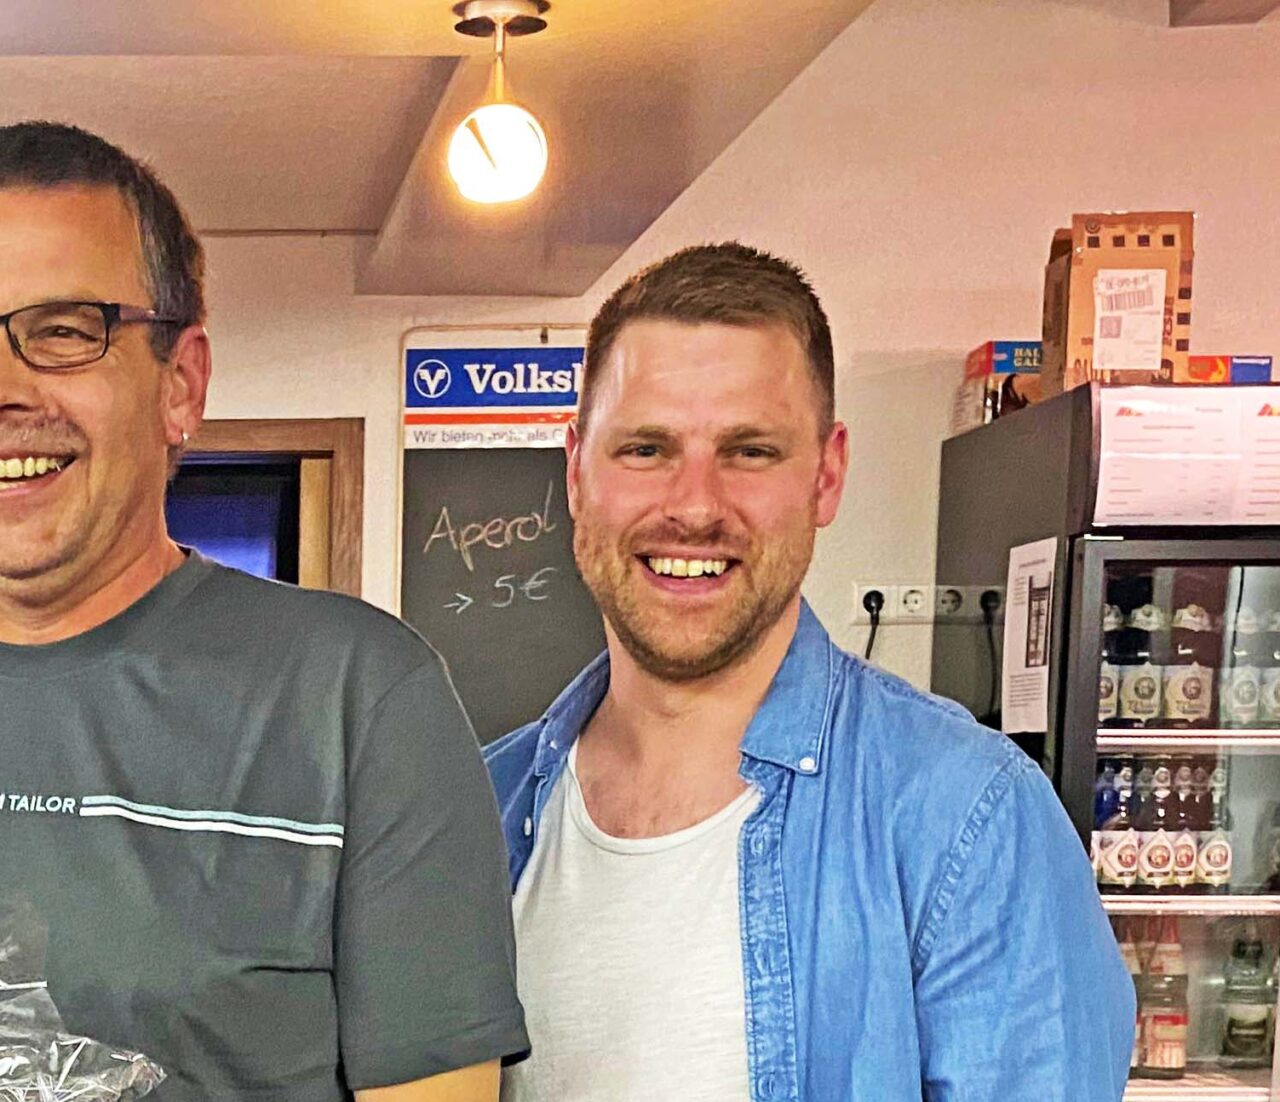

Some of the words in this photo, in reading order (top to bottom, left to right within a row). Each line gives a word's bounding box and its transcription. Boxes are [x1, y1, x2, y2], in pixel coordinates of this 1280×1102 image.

[413, 430, 436, 443] Wir
[423, 480, 557, 572] Aperol
[8, 794, 76, 813] TAILOR
